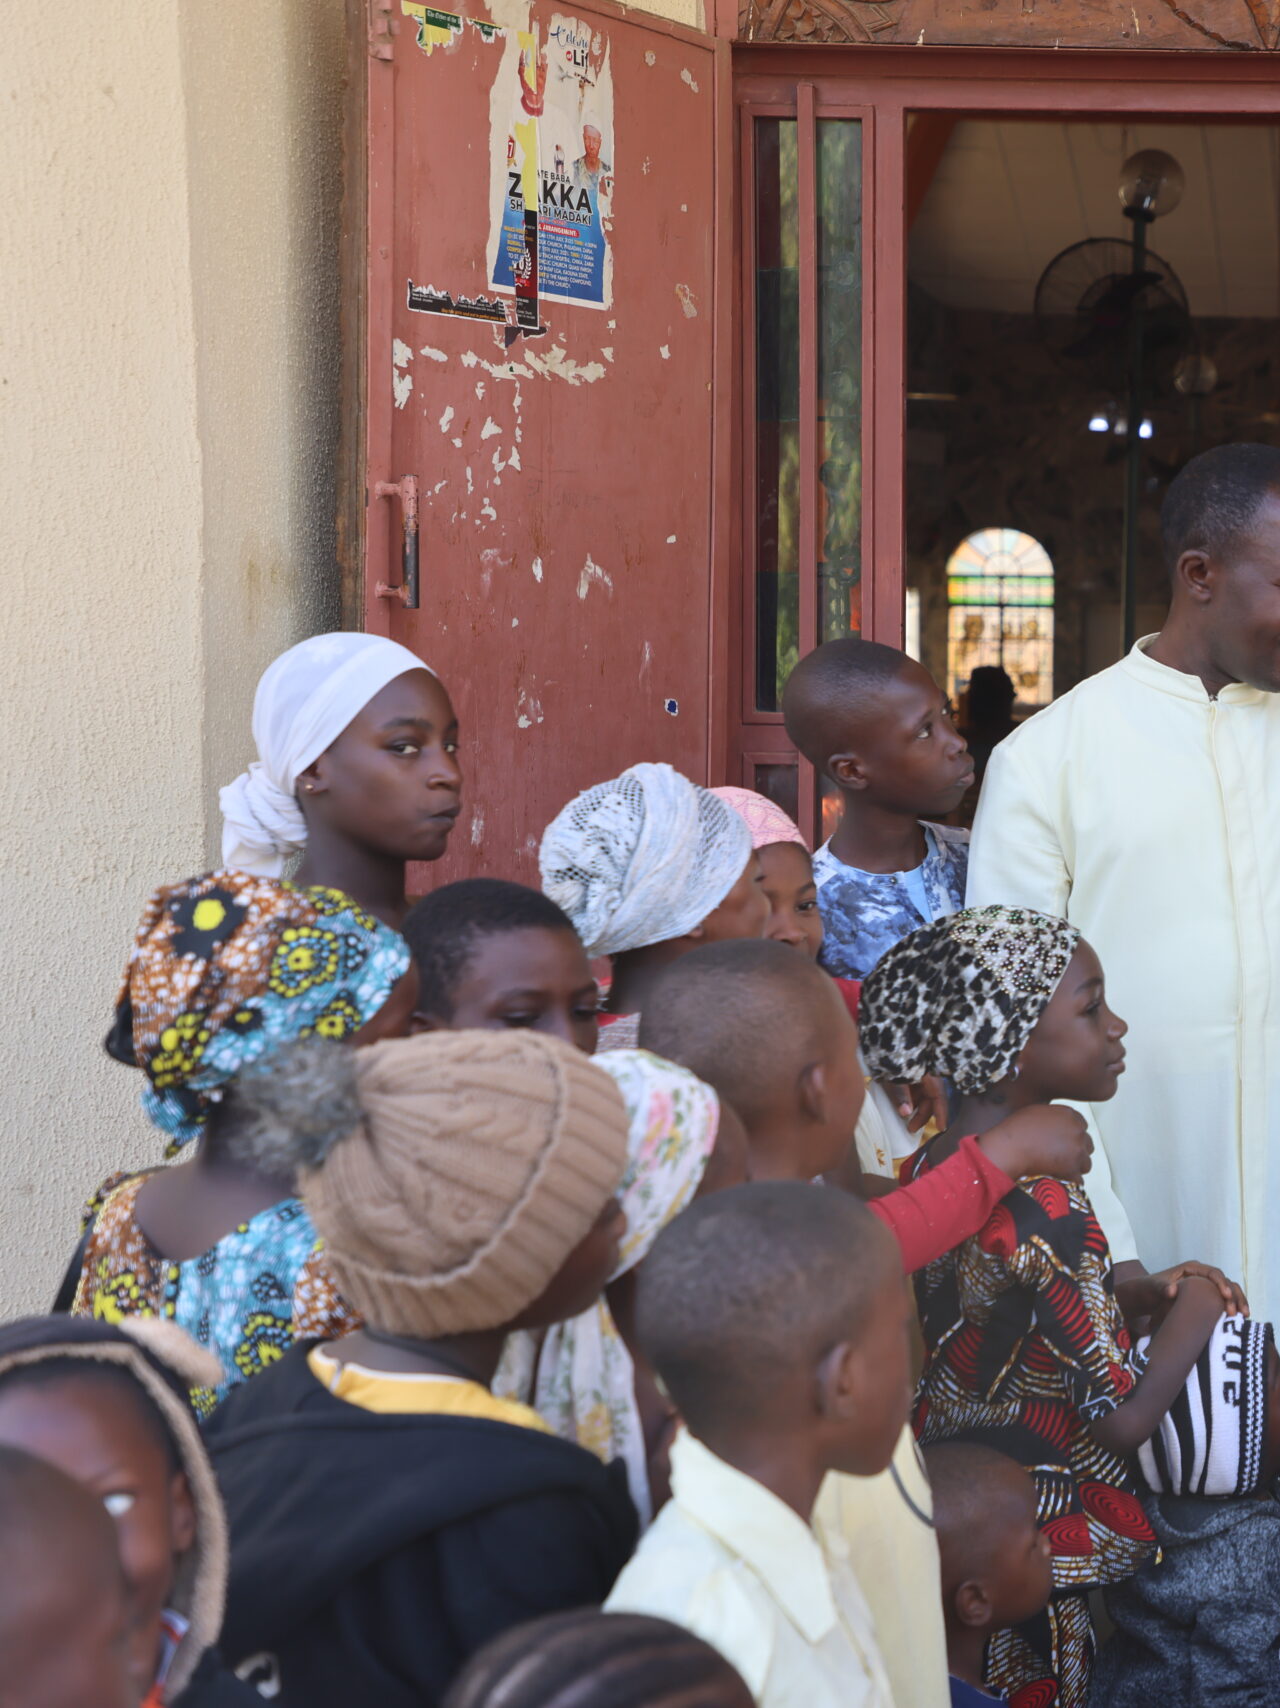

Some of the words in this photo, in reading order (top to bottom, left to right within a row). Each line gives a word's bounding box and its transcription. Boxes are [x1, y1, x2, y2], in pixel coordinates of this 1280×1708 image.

[550, 172, 571, 184] BABA
[508, 171, 593, 214] ZKKA
[554, 206, 592, 226] MADAKI
